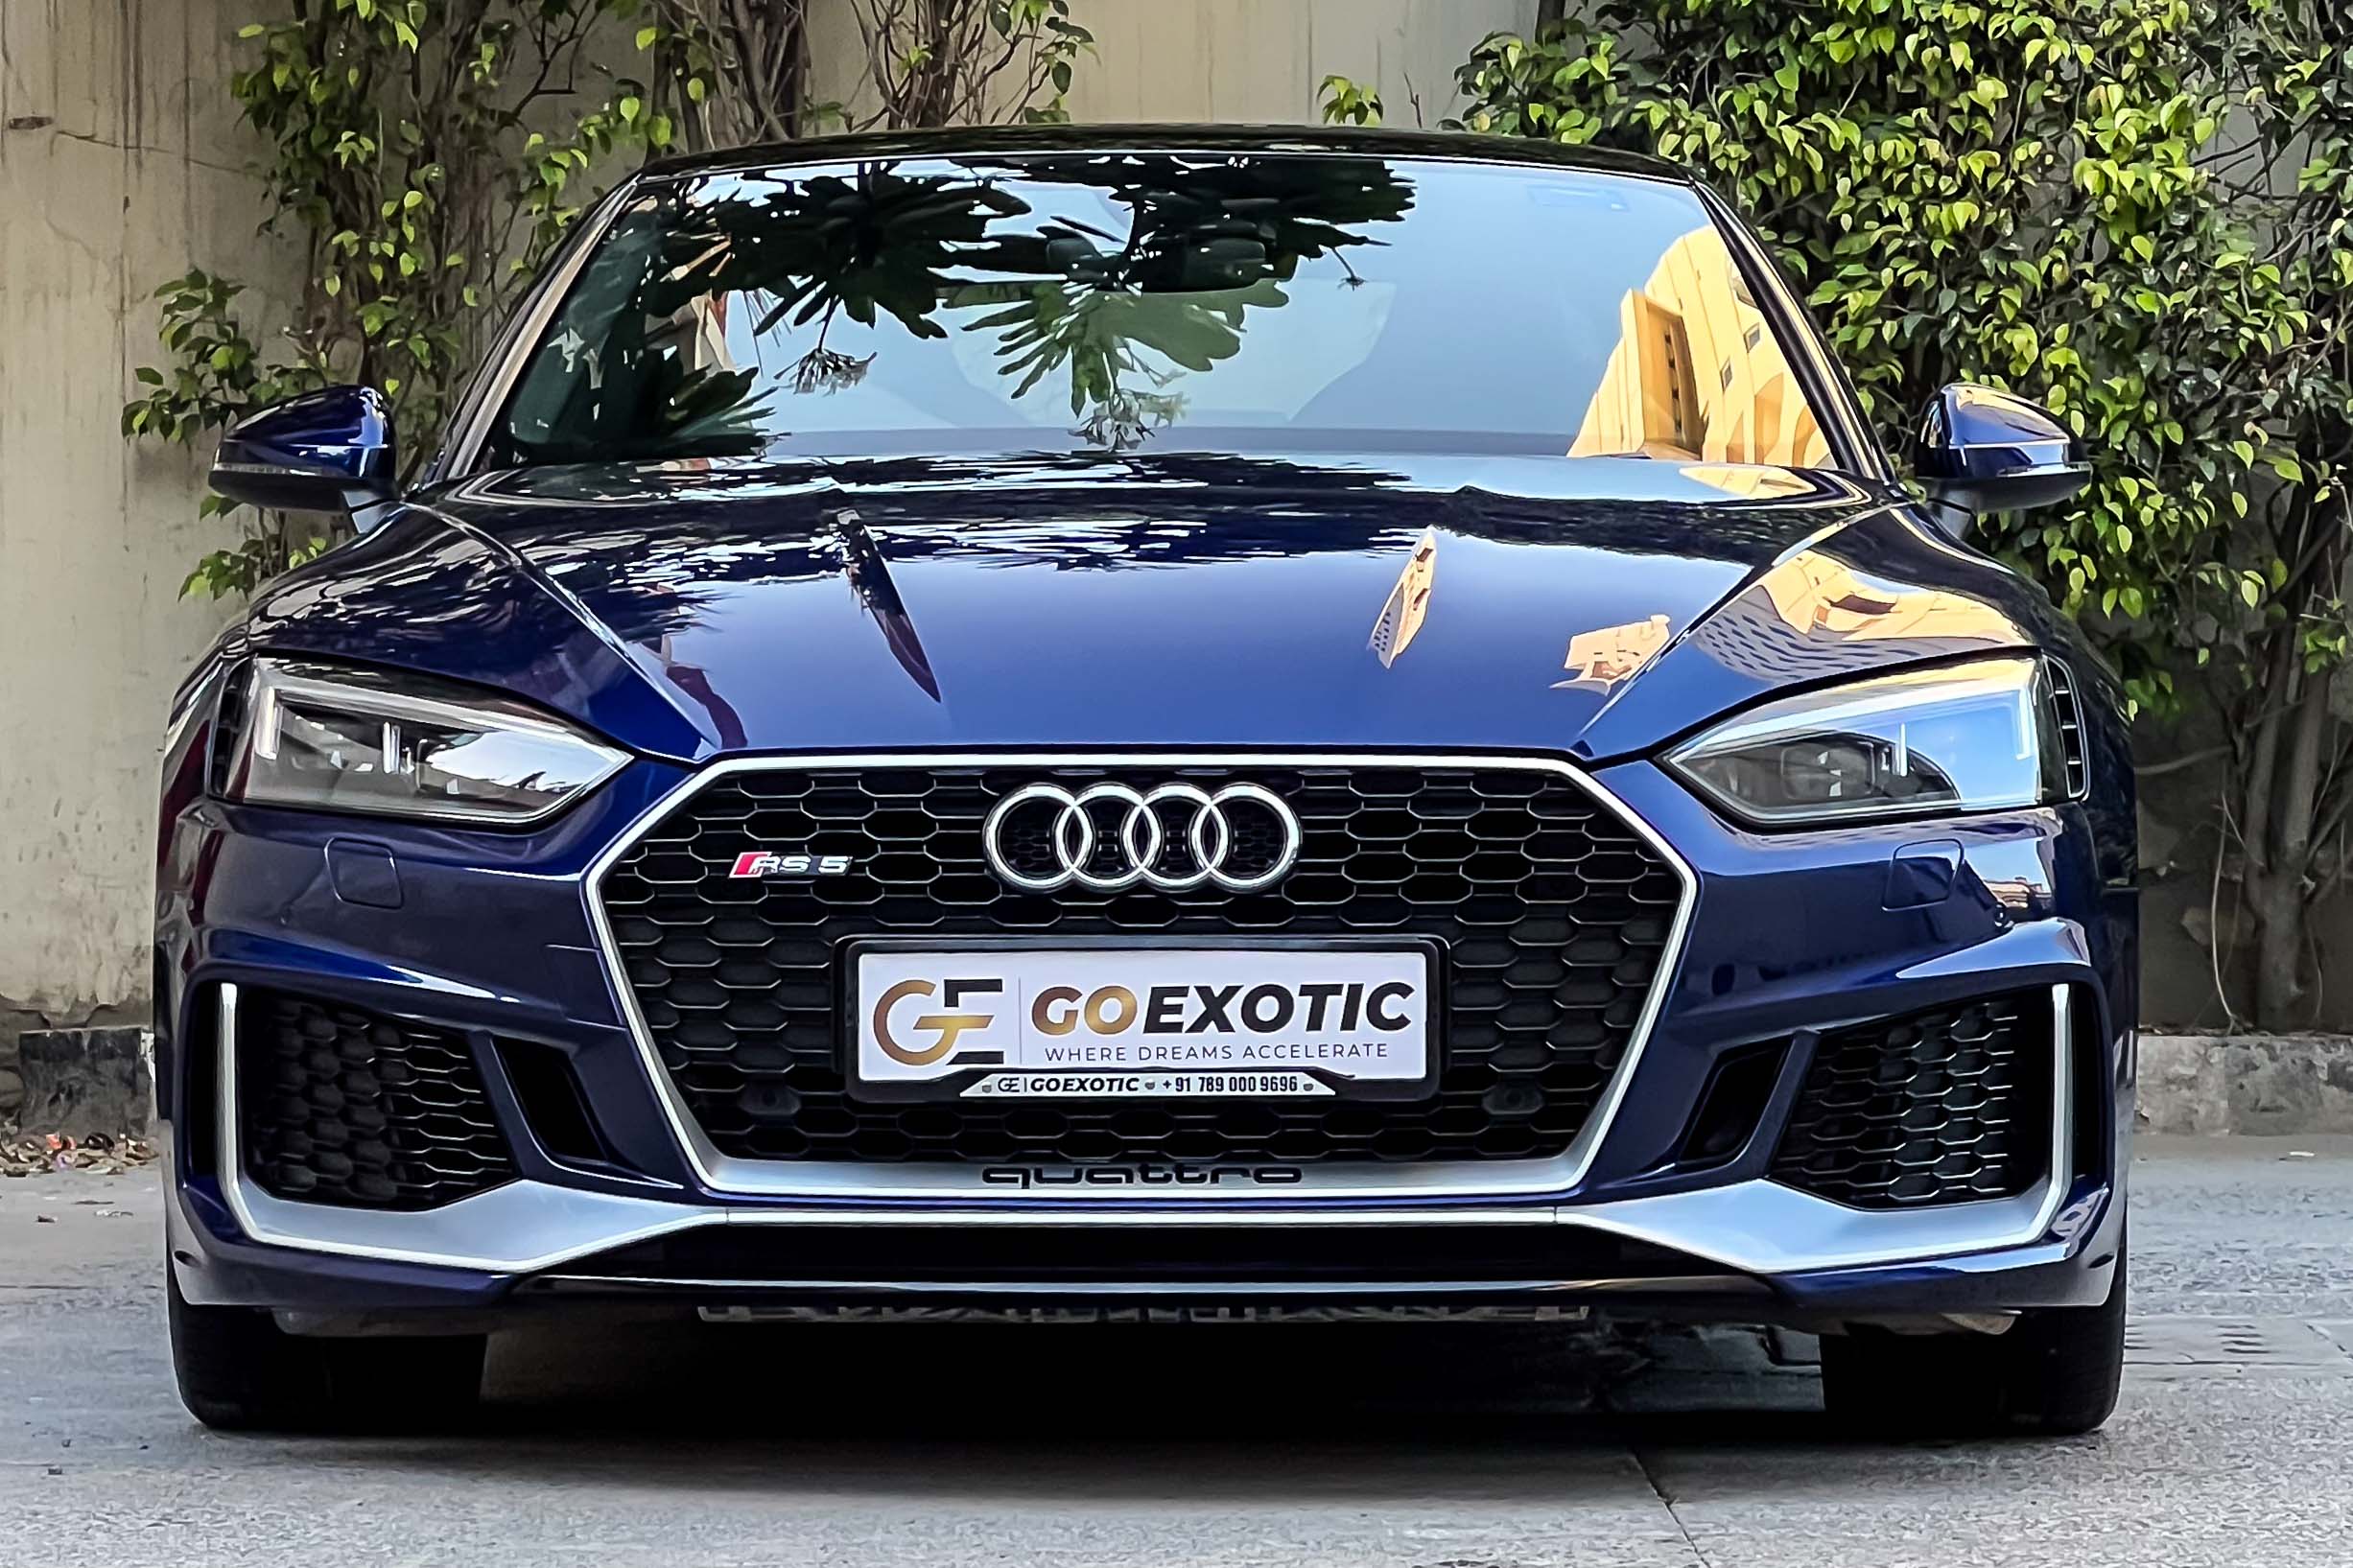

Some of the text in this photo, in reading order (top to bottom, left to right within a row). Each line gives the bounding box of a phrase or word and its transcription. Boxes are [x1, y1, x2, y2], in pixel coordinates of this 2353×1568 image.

[1031, 982, 1415, 1036] GOEXOTIC
[1045, 1043, 1389, 1063] WHERE DREAMS ACCELERATE
[1030, 1077, 1140, 1092] GOEXOTIC
[1199, 1076, 1224, 1092] 789
[1229, 1076, 1257, 1092] 000
[1260, 1076, 1298, 1092] 9696
[981, 1162, 1303, 1189] quattro
